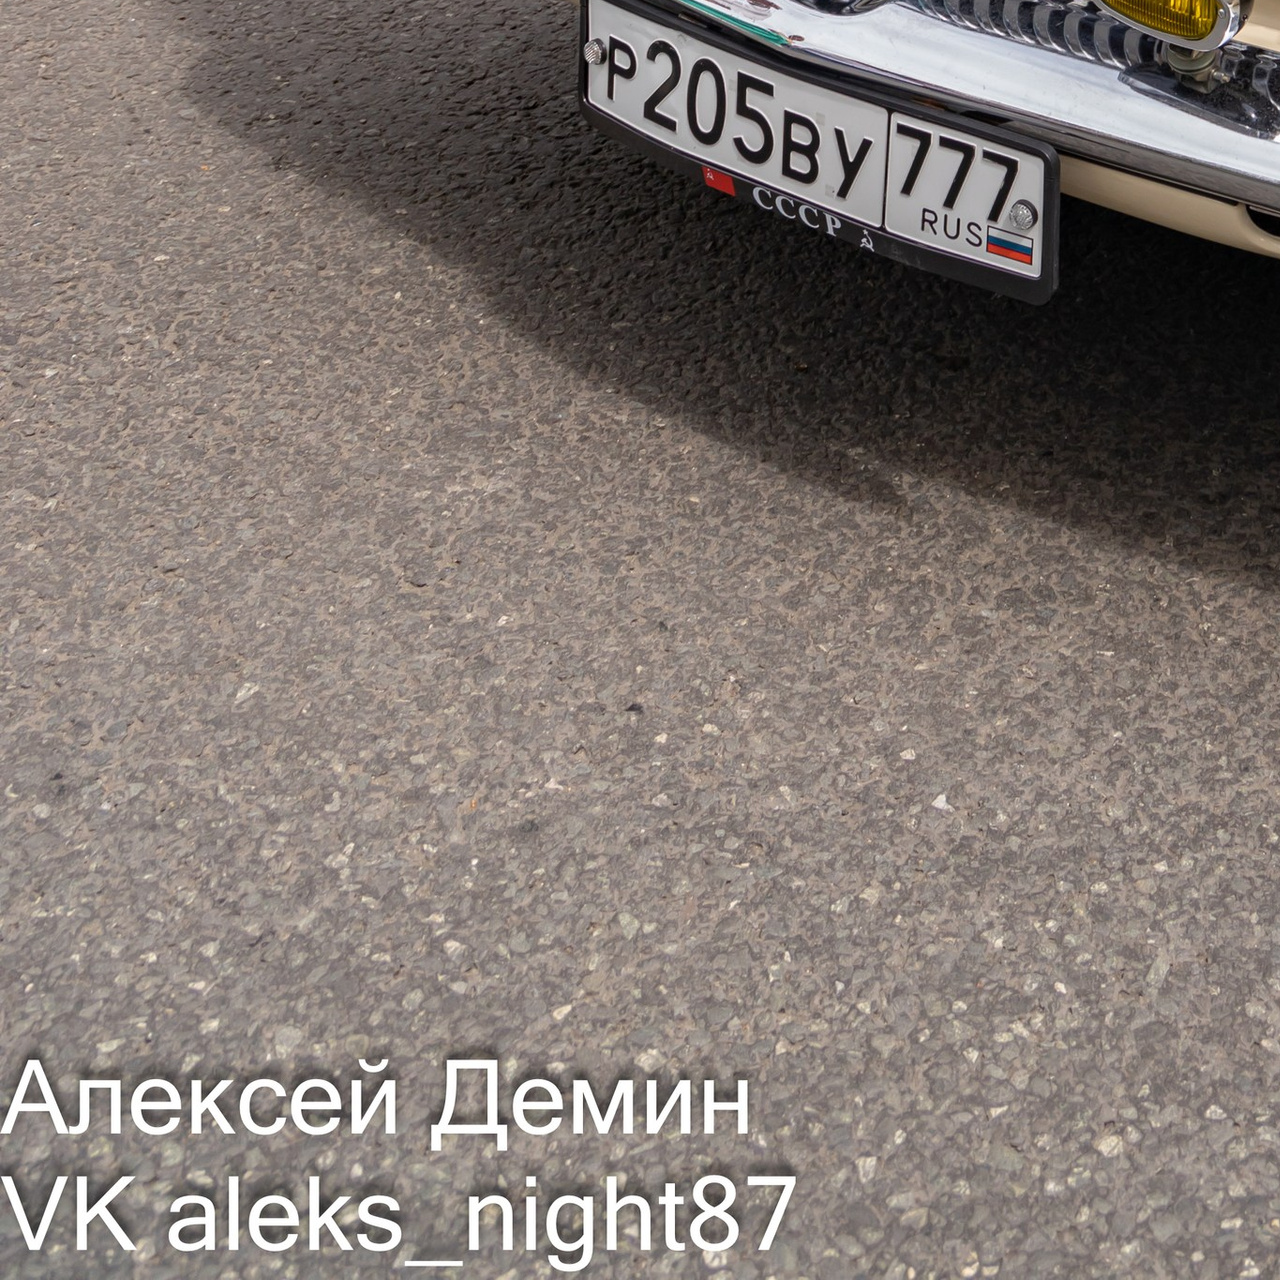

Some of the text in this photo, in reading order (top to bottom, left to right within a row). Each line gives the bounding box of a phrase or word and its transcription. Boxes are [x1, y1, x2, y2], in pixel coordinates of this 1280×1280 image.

[895, 122, 1020, 224] 777
[751, 185, 842, 238] СССР
[920, 209, 983, 249] RUS
